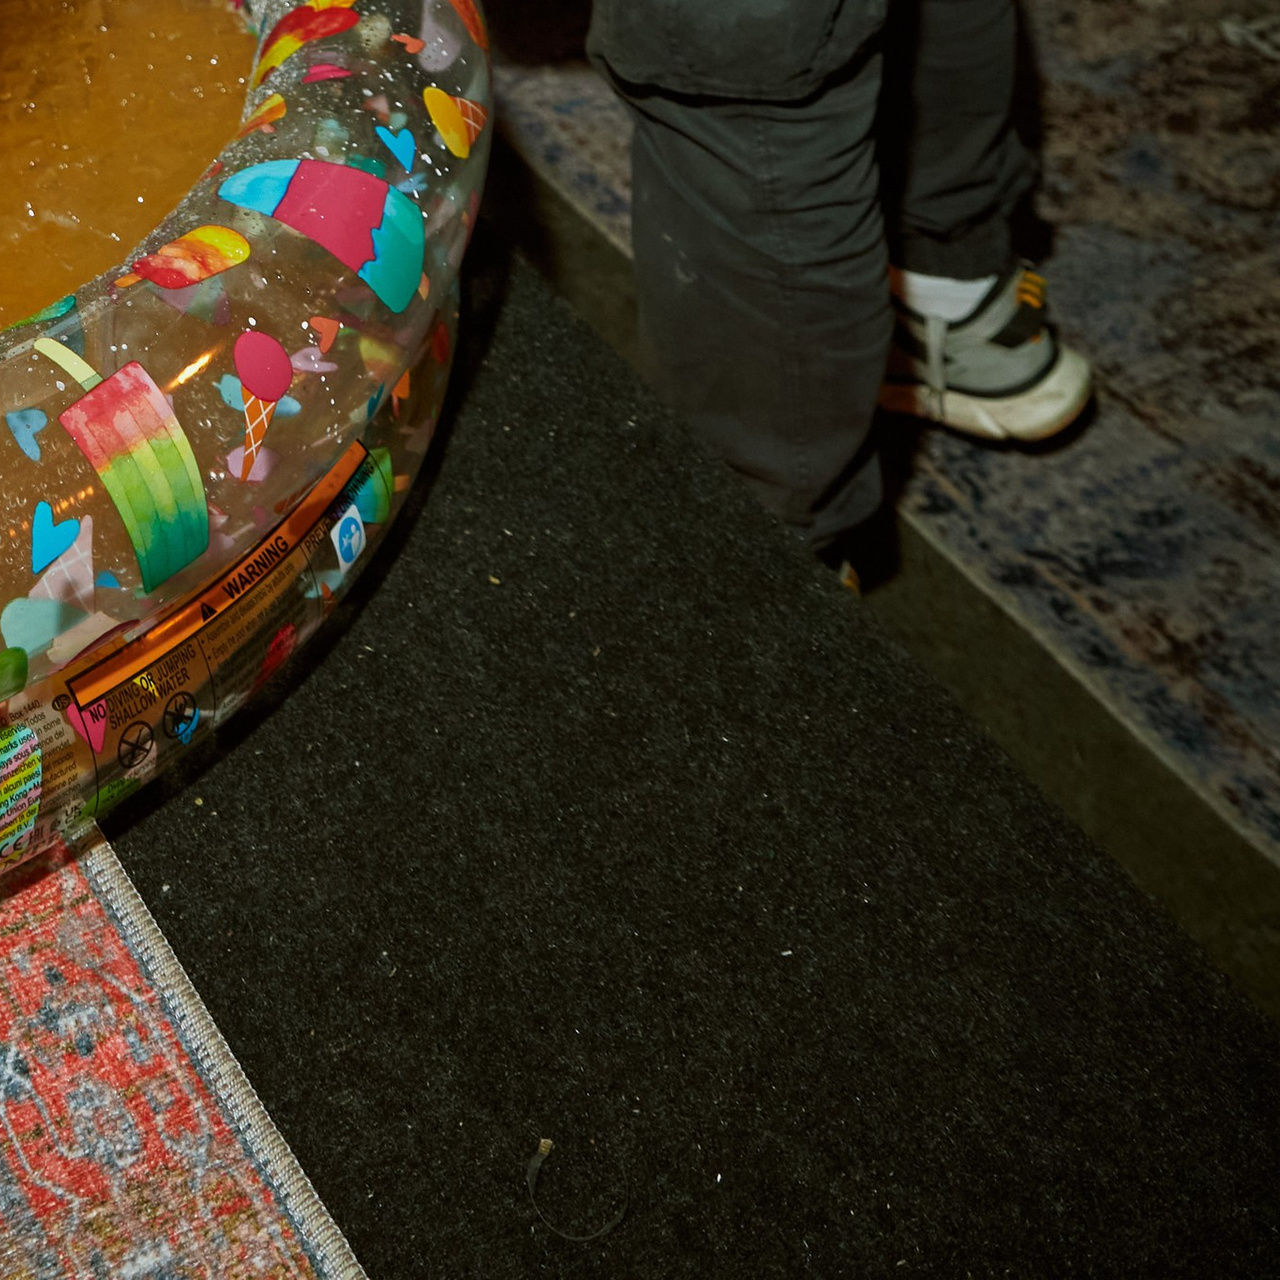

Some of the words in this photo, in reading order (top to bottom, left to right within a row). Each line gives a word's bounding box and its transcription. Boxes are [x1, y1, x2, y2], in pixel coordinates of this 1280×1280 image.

[221, 535, 290, 599] WARNING
[89, 703, 107, 723] NO
[105, 681, 141, 714] DIVING
[139, 672, 157, 691] OR
[157, 644, 197, 681] JUMPING
[109, 689, 158, 730] SHALLOW
[156, 667, 190, 699] WATER
[9, 707, 25, 721] Box
[19, 731, 35, 746] used
[42, 718, 62, 734] some
[13, 749, 30, 763] sous
[5, 800, 26, 816] Union
[9, 790, 28, 807] Kong
